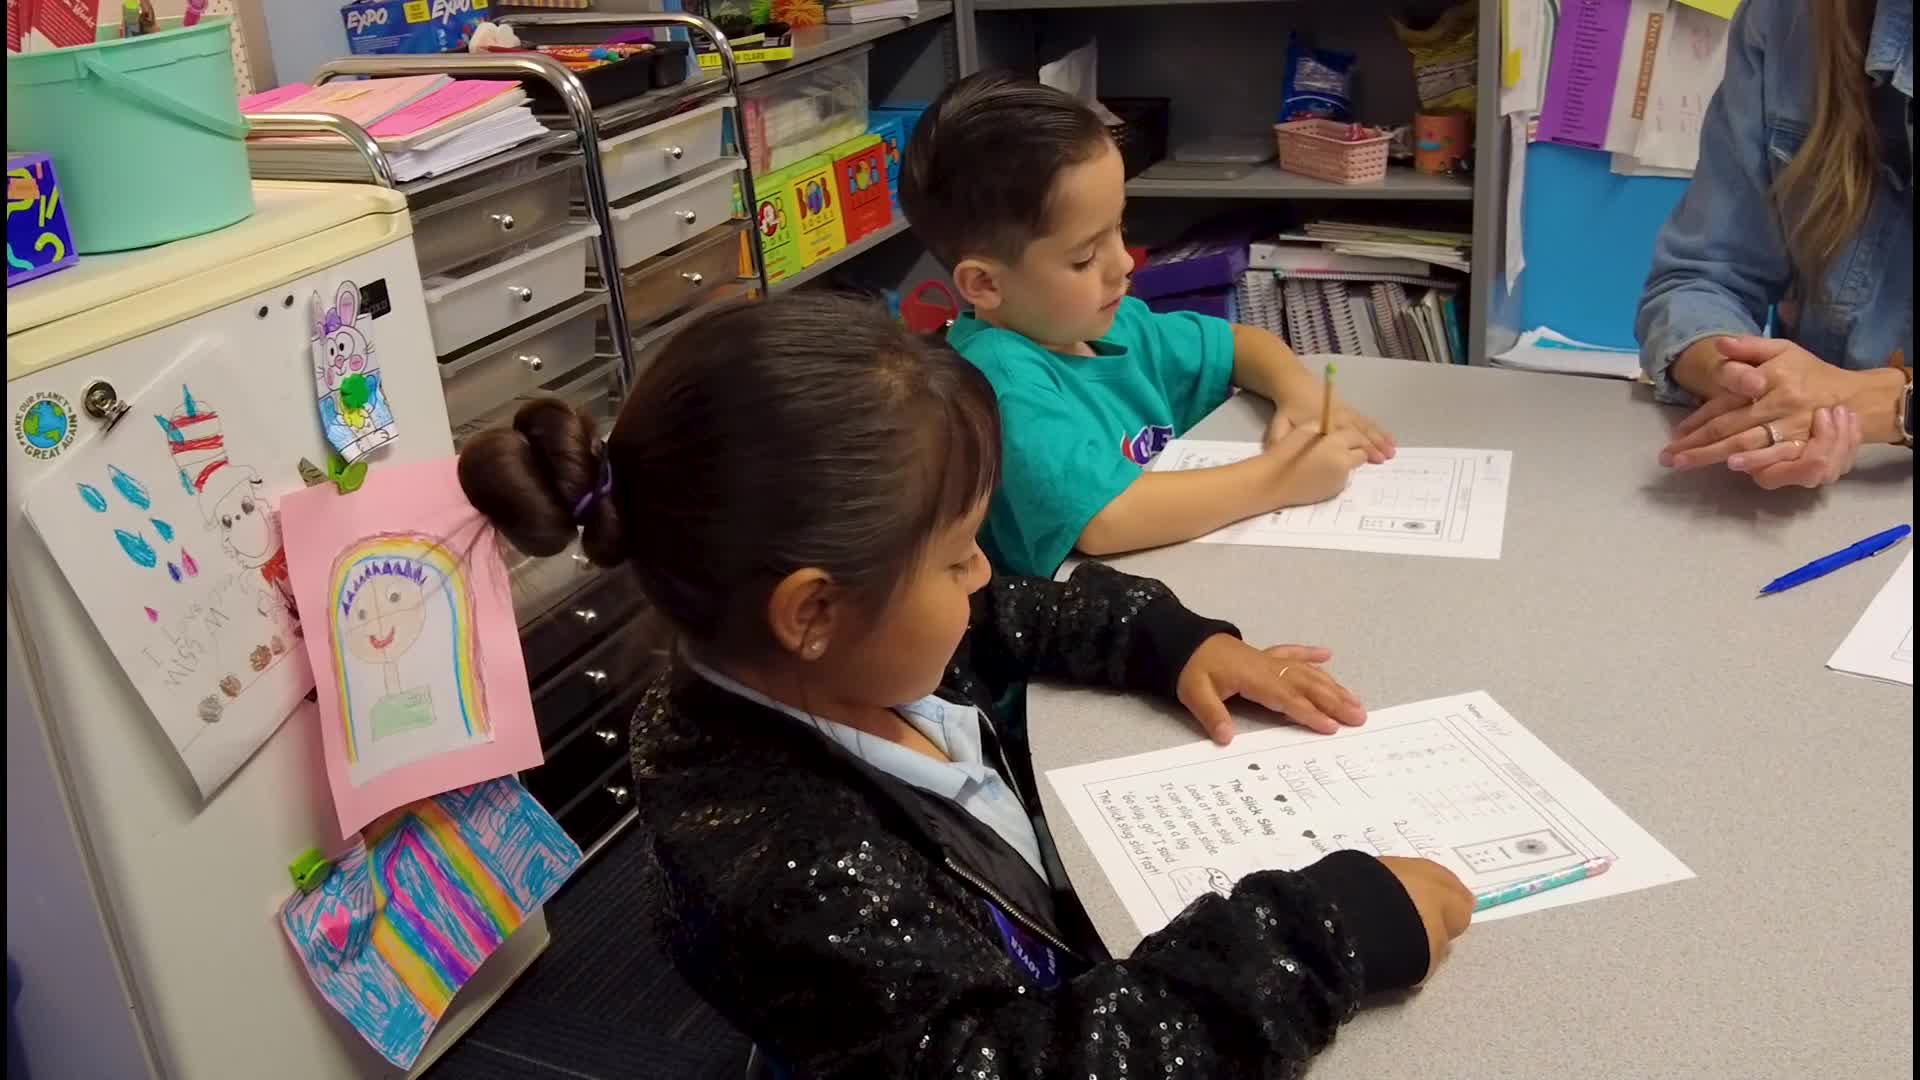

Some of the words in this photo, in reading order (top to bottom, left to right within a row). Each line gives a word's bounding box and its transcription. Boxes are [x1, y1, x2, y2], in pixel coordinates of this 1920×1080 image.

[347, 8, 388, 34] EXPO
[758, 196, 787, 237] OB
[795, 177, 832, 219] BOB
[15, 415, 24, 440] MAKE
[20, 396, 35, 412] OUR
[36, 392, 69, 407] PLANET
[24, 446, 61, 460] GREAT
[62, 414, 77, 450] AGAIN
[1145, 794, 1160, 804] It
[1152, 802, 1170, 819] slid
[1160, 782, 1174, 792] It
[1167, 791, 1183, 805] can
[1176, 802, 1193, 821] slip
[1187, 819, 1206, 837] and
[1184, 784, 1204, 803] Look
[1199, 801, 1213, 813] at
[1207, 812, 1222, 828] the
[1217, 825, 1241, 847] slug!
[1213, 789, 1232, 808] slug
[1226, 805, 1239, 817] is
[1227, 778, 1244, 793] The
[1241, 795, 1263, 816] Slick
[1257, 818, 1276, 836] Slug
[1279, 806, 1296, 816] go
[1098, 789, 1112, 805] The
[1105, 801, 1125, 823] slick
[1117, 821, 1136, 840] slug
[1129, 838, 1146, 856] slid
[1139, 855, 1165, 876] fast!
[1163, 818, 1178, 831] on
